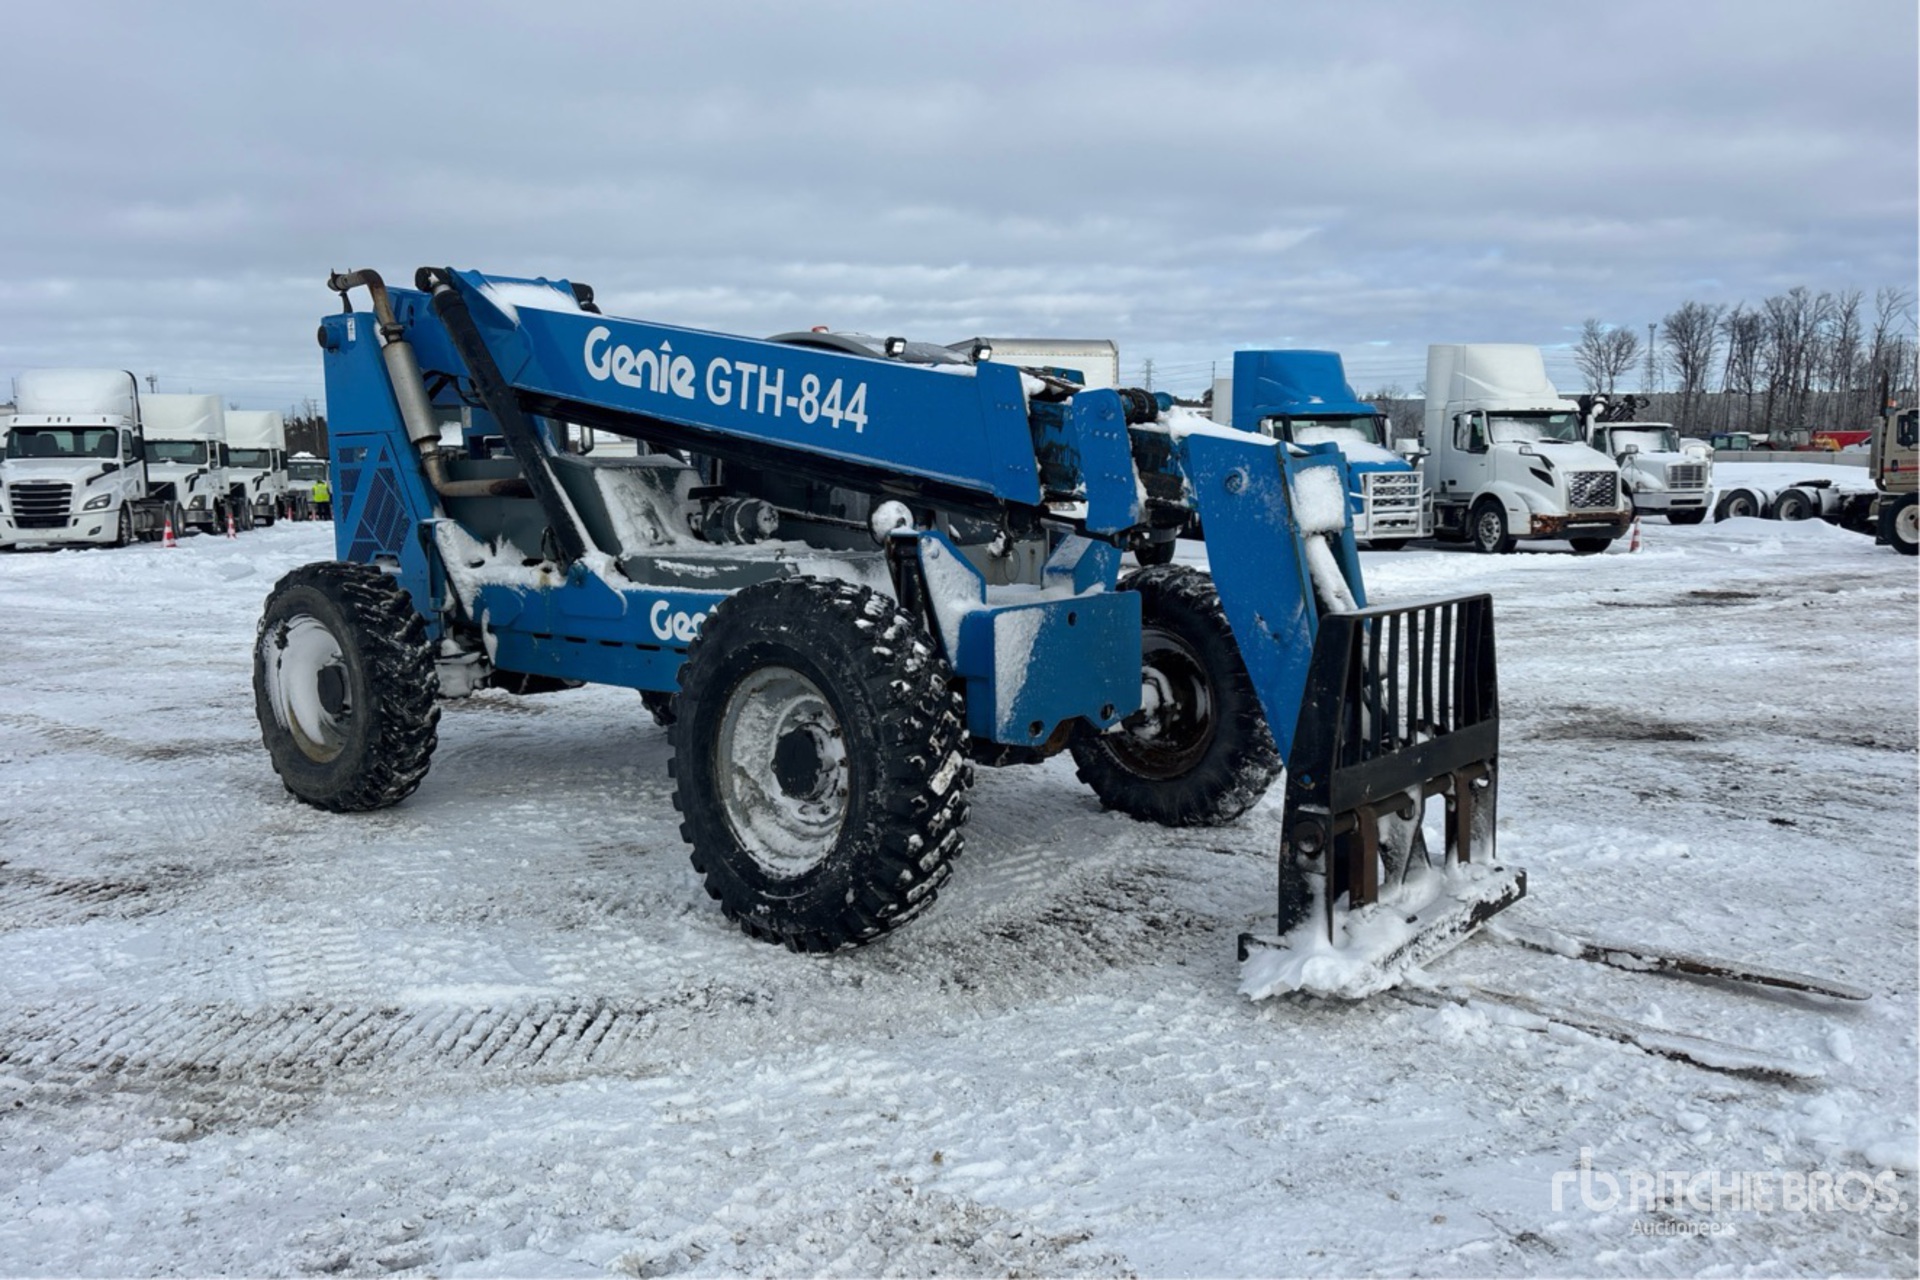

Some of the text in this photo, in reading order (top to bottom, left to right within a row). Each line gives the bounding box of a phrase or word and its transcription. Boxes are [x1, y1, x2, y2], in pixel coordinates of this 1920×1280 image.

[584, 326, 868, 434] Genie GTH-844
[650, 600, 719, 642] Gen
